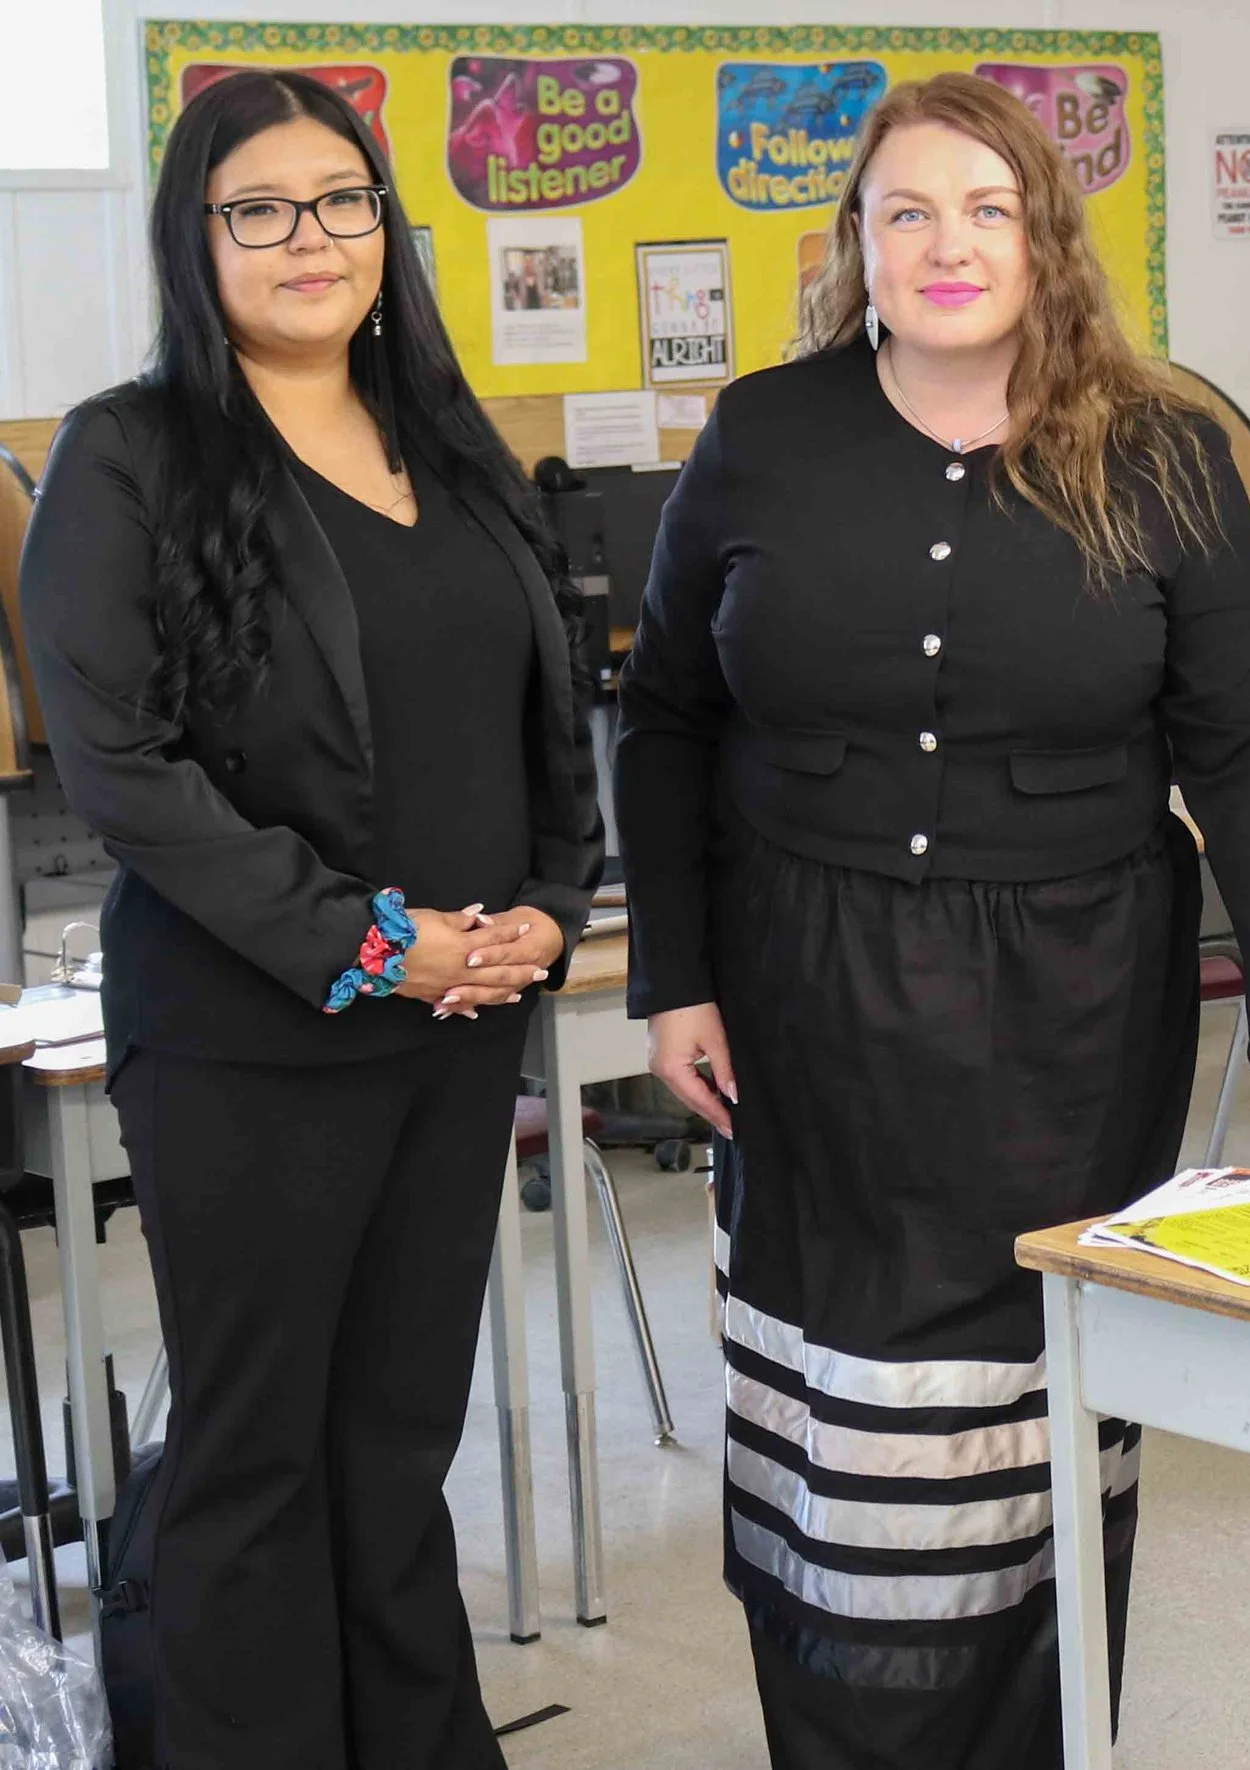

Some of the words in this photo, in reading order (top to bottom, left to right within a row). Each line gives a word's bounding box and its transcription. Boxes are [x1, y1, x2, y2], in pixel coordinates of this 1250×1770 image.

[537, 75, 586, 116] Be
[595, 89, 620, 116] a
[1056, 92, 1110, 139] Be
[537, 109, 631, 164] good
[752, 122, 856, 166] Follow
[487, 155, 627, 203] listener
[728, 157, 850, 205] directio
[651, 336, 726, 367] ALRIGHT
